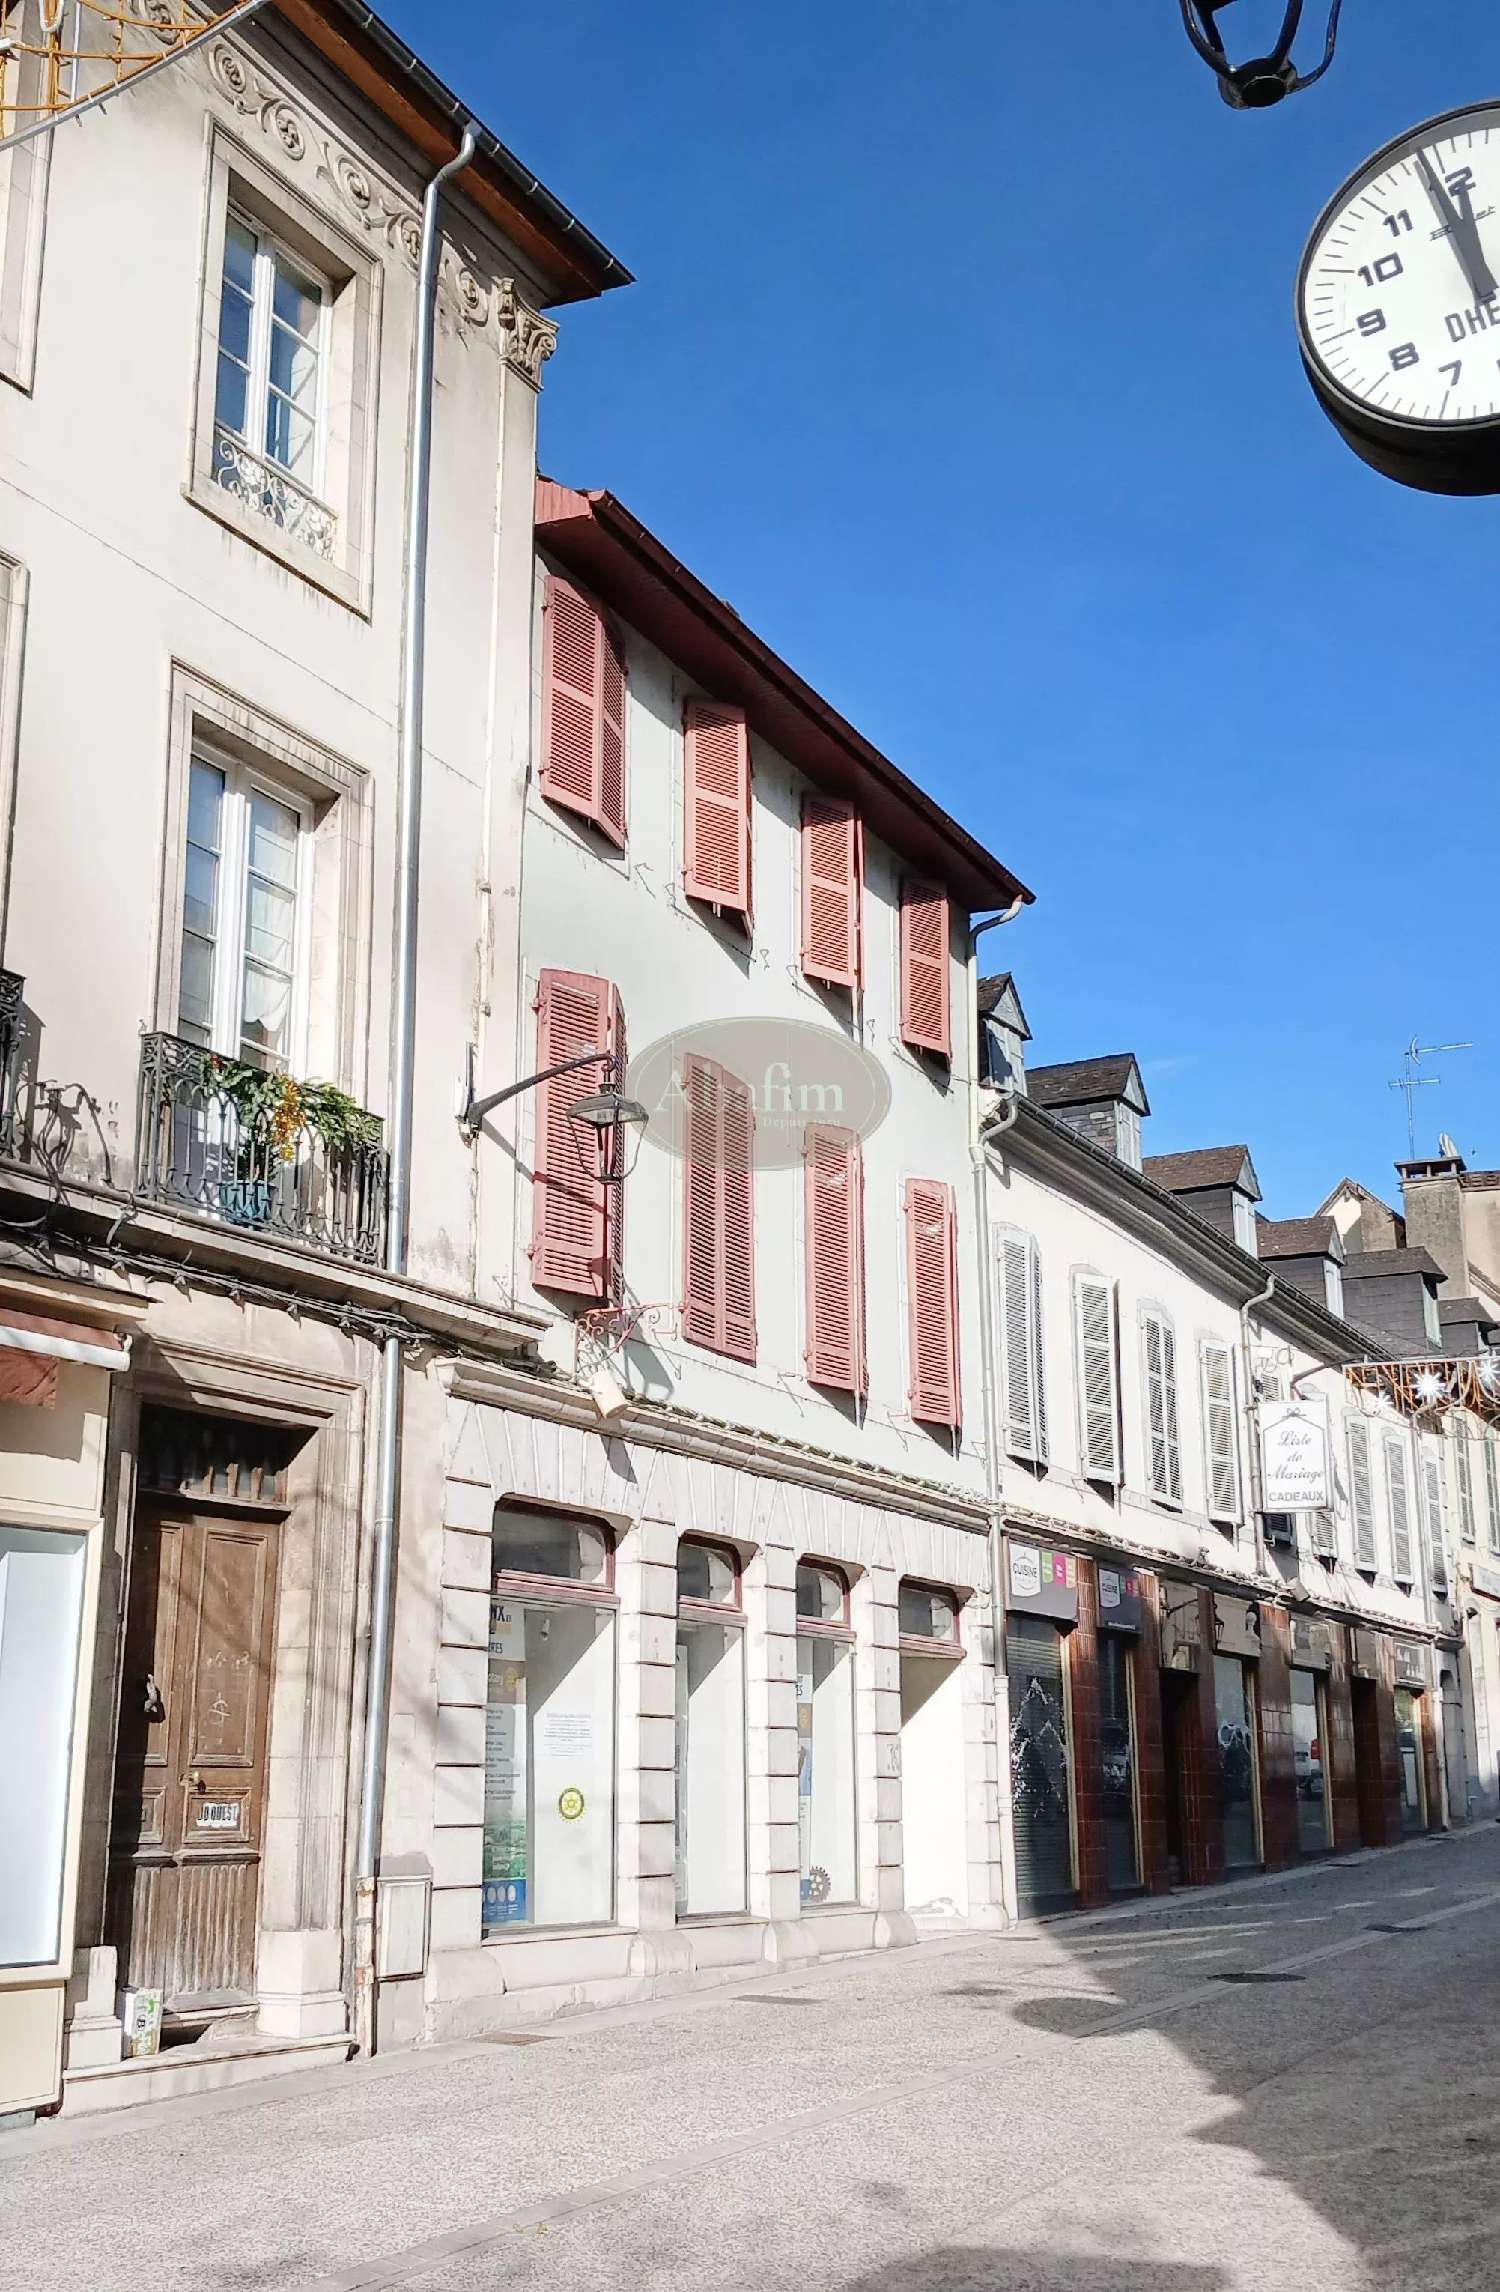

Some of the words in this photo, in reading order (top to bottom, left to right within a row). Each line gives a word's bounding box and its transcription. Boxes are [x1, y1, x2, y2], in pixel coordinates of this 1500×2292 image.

[1383, 209, 1413, 237] 11
[1357, 252, 1404, 287] 10
[1356, 308, 1387, 337] 9
[1388, 342, 1420, 372] 8
[1438, 359, 1463, 387] 7
[1278, 1430, 1312, 1447] Liste
[1287, 1450, 1303, 1463] de
[1267, 1464, 1324, 1484] Mariage
[1268, 1491, 1324, 1502] CADEAUX
